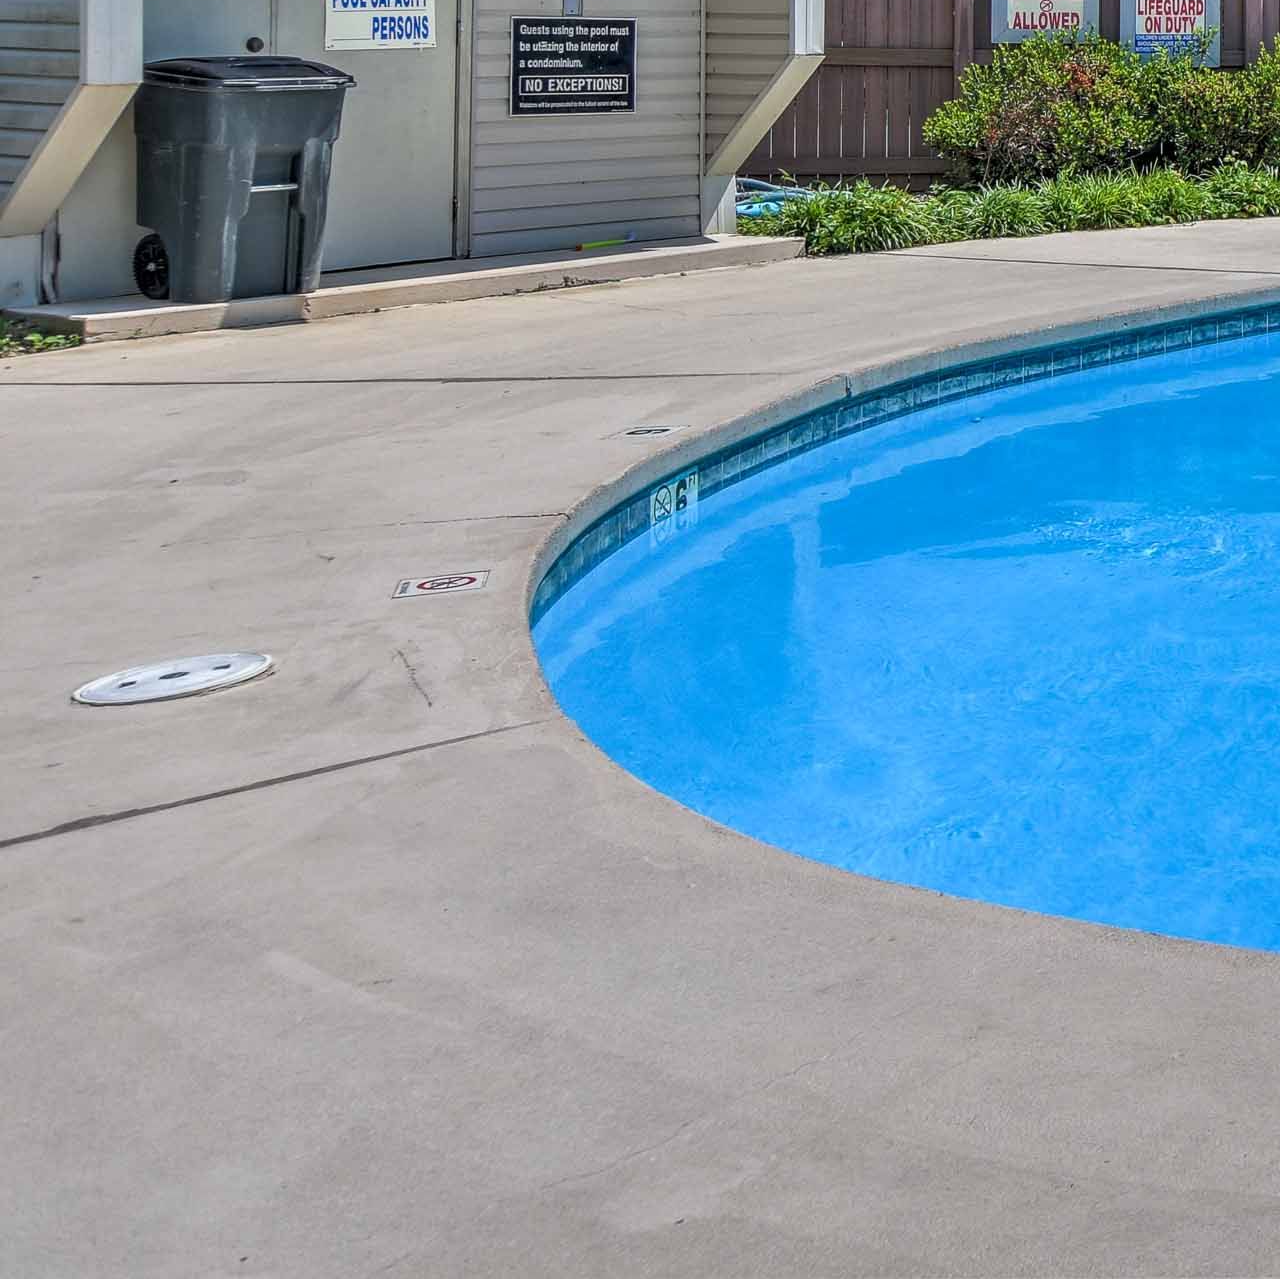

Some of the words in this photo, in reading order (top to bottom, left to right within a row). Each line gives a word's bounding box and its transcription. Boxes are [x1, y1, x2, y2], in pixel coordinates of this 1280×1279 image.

[1138, 0, 1203, 15] LIFEGUARD
[372, 16, 429, 40] PERSONS
[1013, 12, 1080, 30] ALLOWED
[1145, 16, 1161, 33] ON
[1166, 17, 1196, 33] DUTY
[520, 24, 550, 34] Guests
[552, 25, 574, 37] using
[576, 26, 588, 35] the
[591, 25, 608, 37] pool
[610, 26, 629, 35] must
[520, 41, 530, 51] be
[533, 41, 564, 53] utilizing
[566, 41, 578, 51] the
[581, 41, 608, 51] interior
[610, 41, 619, 52] of
[528, 58, 583, 68] condominium.
[526, 80, 543, 91] NO
[548, 79, 623, 91] EXCEPTIONS!
